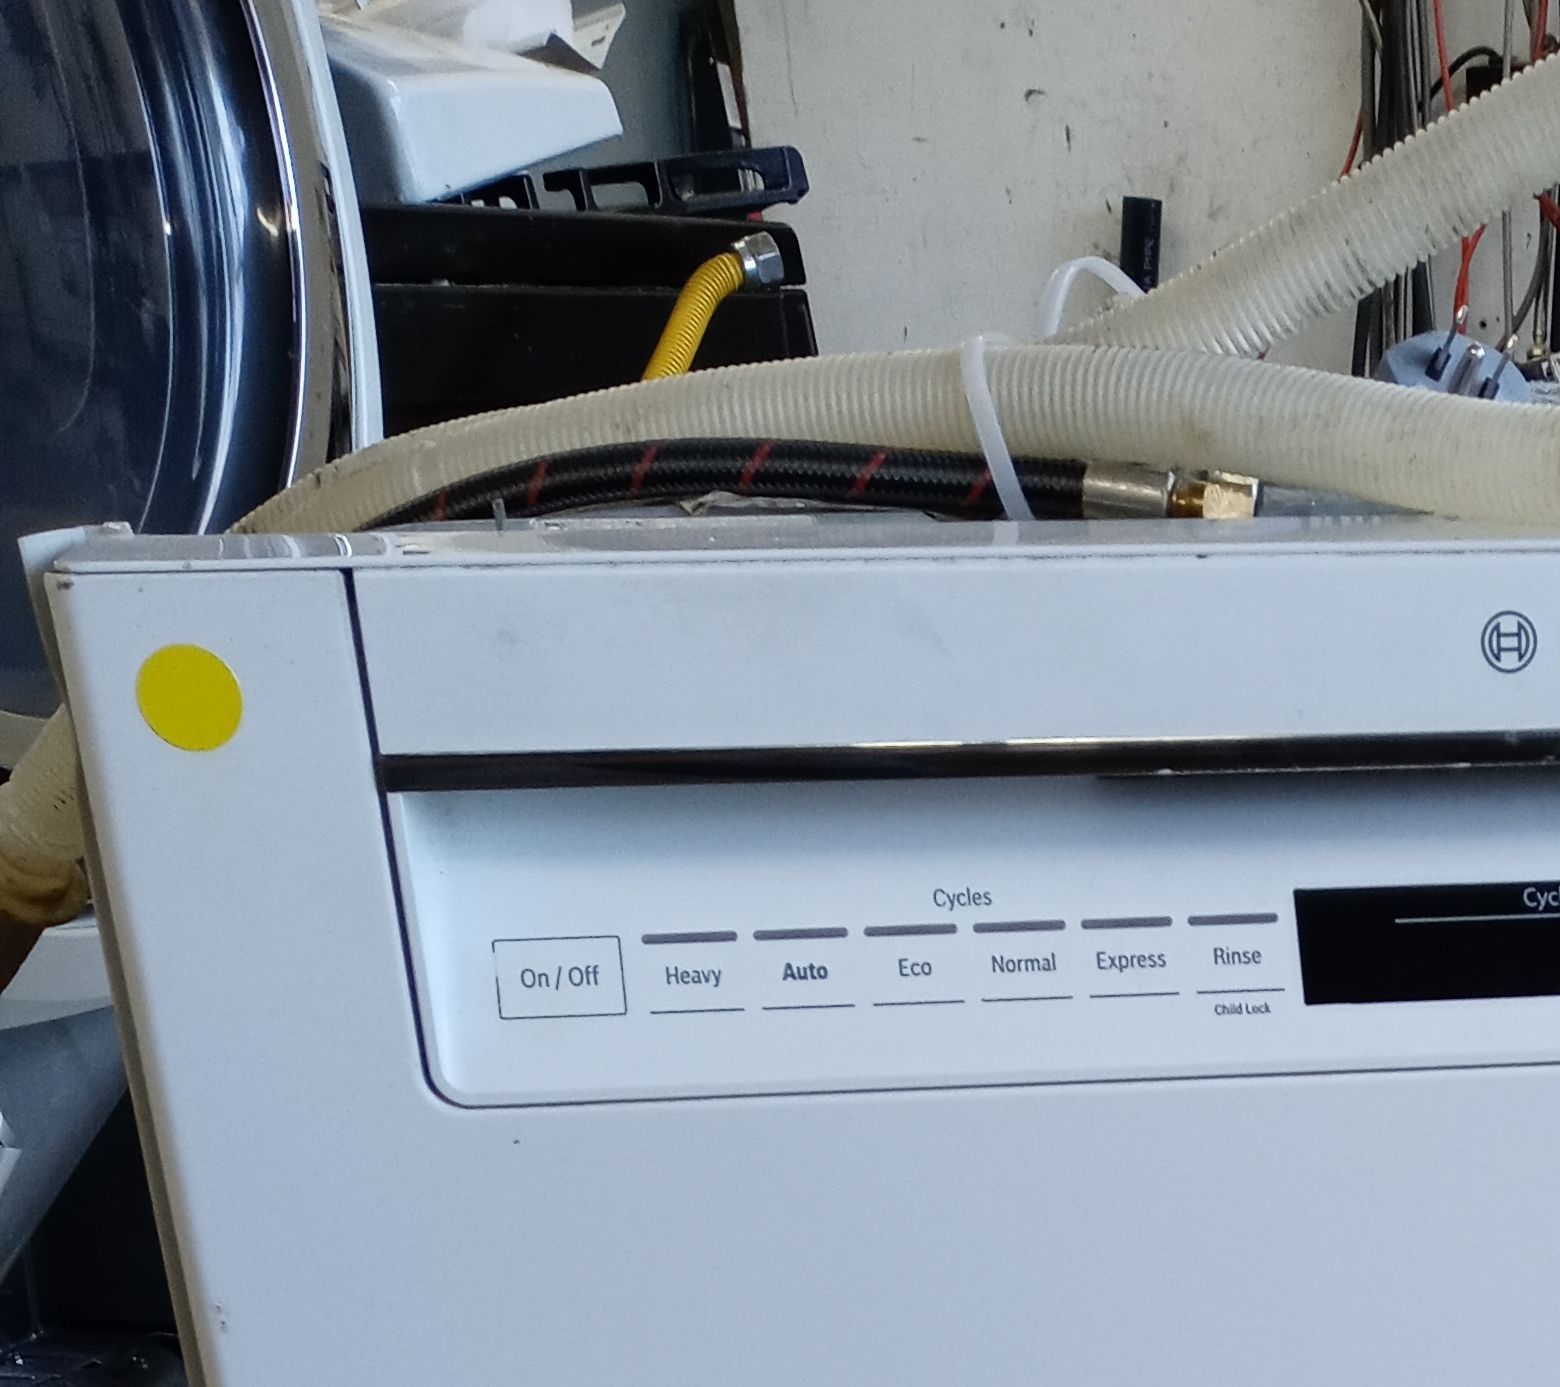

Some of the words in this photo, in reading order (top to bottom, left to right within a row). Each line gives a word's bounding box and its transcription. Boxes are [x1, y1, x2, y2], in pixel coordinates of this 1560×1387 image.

[933, 887, 993, 911] Cycles
[992, 952, 1057, 974] Normal
[1096, 951, 1167, 973] Express
[1213, 947, 1262, 966] Rinse
[521, 968, 550, 988] On
[569, 965, 599, 986] Off
[666, 966, 722, 987] Heavy
[783, 962, 829, 981] Auto
[898, 958, 932, 977] Eco
[1214, 1002, 1243, 1016] Child
[1245, 1001, 1271, 1015] Lock
